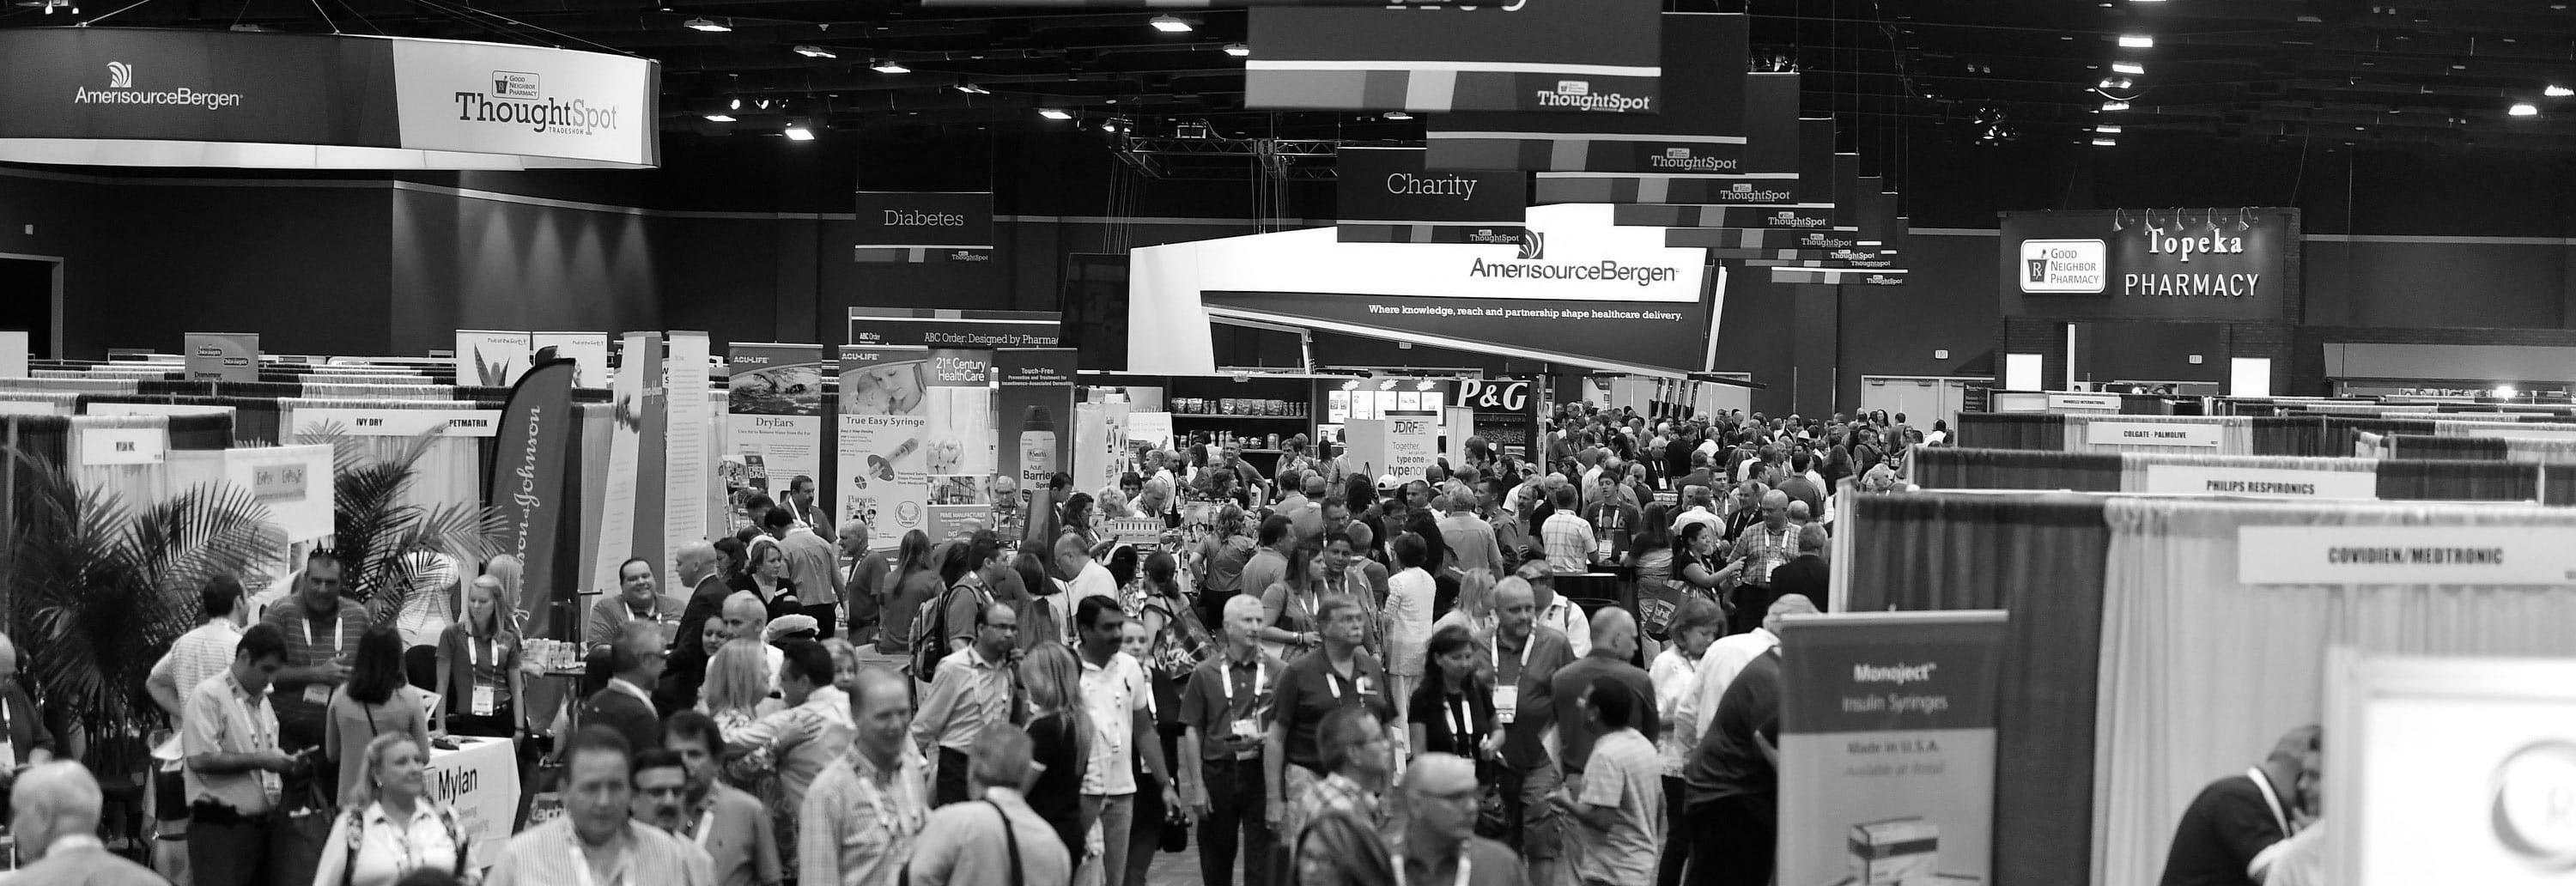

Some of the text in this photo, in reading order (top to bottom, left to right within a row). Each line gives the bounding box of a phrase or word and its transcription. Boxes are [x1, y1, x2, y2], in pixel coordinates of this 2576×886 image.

[75, 86, 240, 111] AmerisourceBergen
[1538, 90, 1650, 112] ThoughtSpot
[455, 92, 617, 136] ThoughtSpot
[549, 126, 585, 135] TRADESHOW
[1651, 155, 1737, 171] ThoughtSpot
[1387, 173, 1478, 201] Charity
[1720, 190, 1790, 203] ThoughtSpot
[884, 209, 963, 226] Diabetes
[1768, 216, 1826, 227] ThoughtSpot
[1469, 234, 1520, 243] ThoughtSpot
[1801, 238, 1852, 248] ThoughtSpot
[2144, 228, 2244, 262] Topeka
[1831, 252, 1875, 260] ThoughtSpot
[2050, 248, 2077, 258] GOOD
[1470, 258, 1675, 287] AmerisourceBergen
[2050, 261, 2096, 271] NEIGHBOR
[2050, 273, 2099, 284] PHARMACY
[2125, 273, 2259, 296] PHARMACY
[1368, 305, 1683, 321] Where knowledge, reach and partnership shape healthcare delivery.
[925, 332, 941, 343] ABC
[969, 333, 1008, 346] Designed
[1010, 334, 1021, 346] by
[952, 357, 986, 373] Century
[938, 369, 986, 382] HealthCare
[1457, 379, 1528, 411] P&G
[356, 418, 383, 427] IVY DRY
[449, 419, 488, 428] PETMATRIX
[756, 417, 794, 428] DryEars
[846, 416, 925, 428] True Easy Syringe
[1393, 421, 1419, 434] JDRF
[1397, 456, 1411, 464] type
[1023, 470, 1054, 480] Barrier
[2207, 480, 2315, 495] PHILIPS RESPIRONICS
[2328, 546, 2504, 565] COVIDIEN/MEDTRONIC
[439, 766, 477, 804] Mylan
